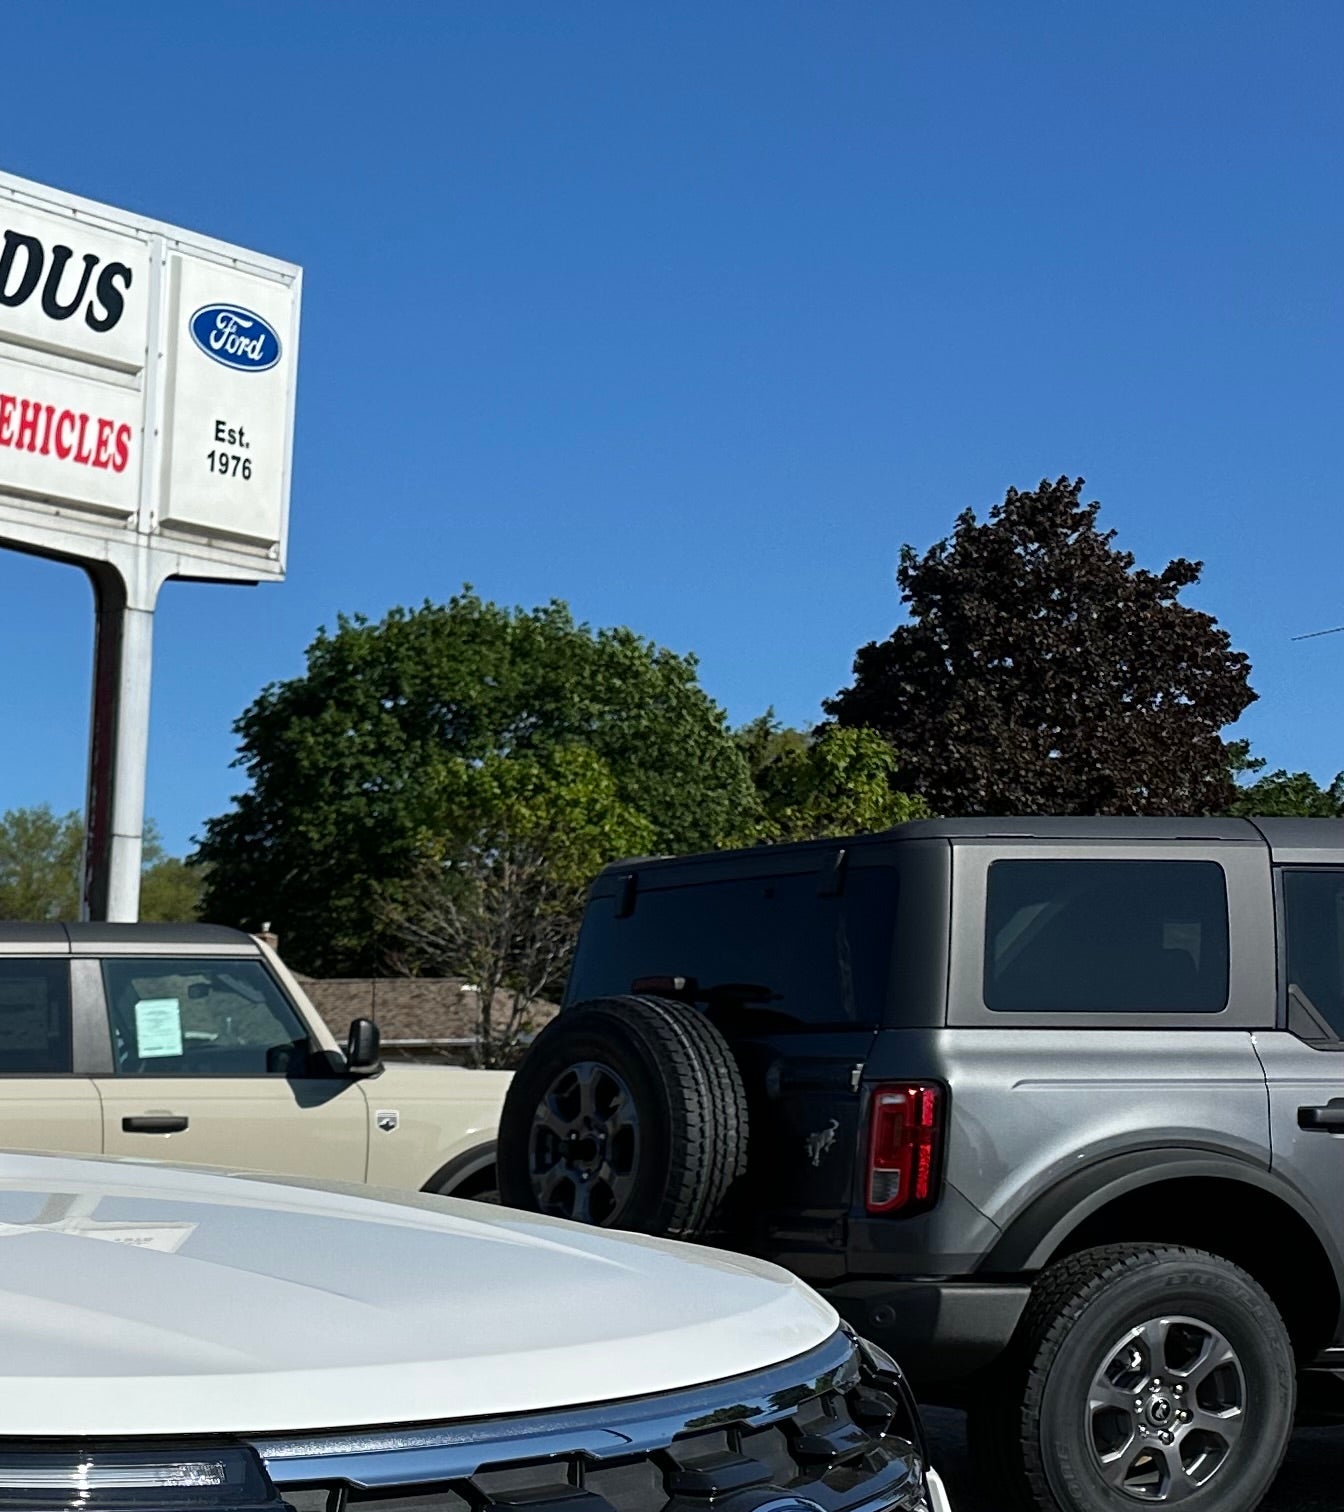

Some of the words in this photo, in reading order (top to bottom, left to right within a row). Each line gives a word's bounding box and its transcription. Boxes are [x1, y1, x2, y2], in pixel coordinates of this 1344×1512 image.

[210, 311, 265, 361] Ford
[214, 420, 251, 449] Est.
[206, 449, 252, 481] 1976
